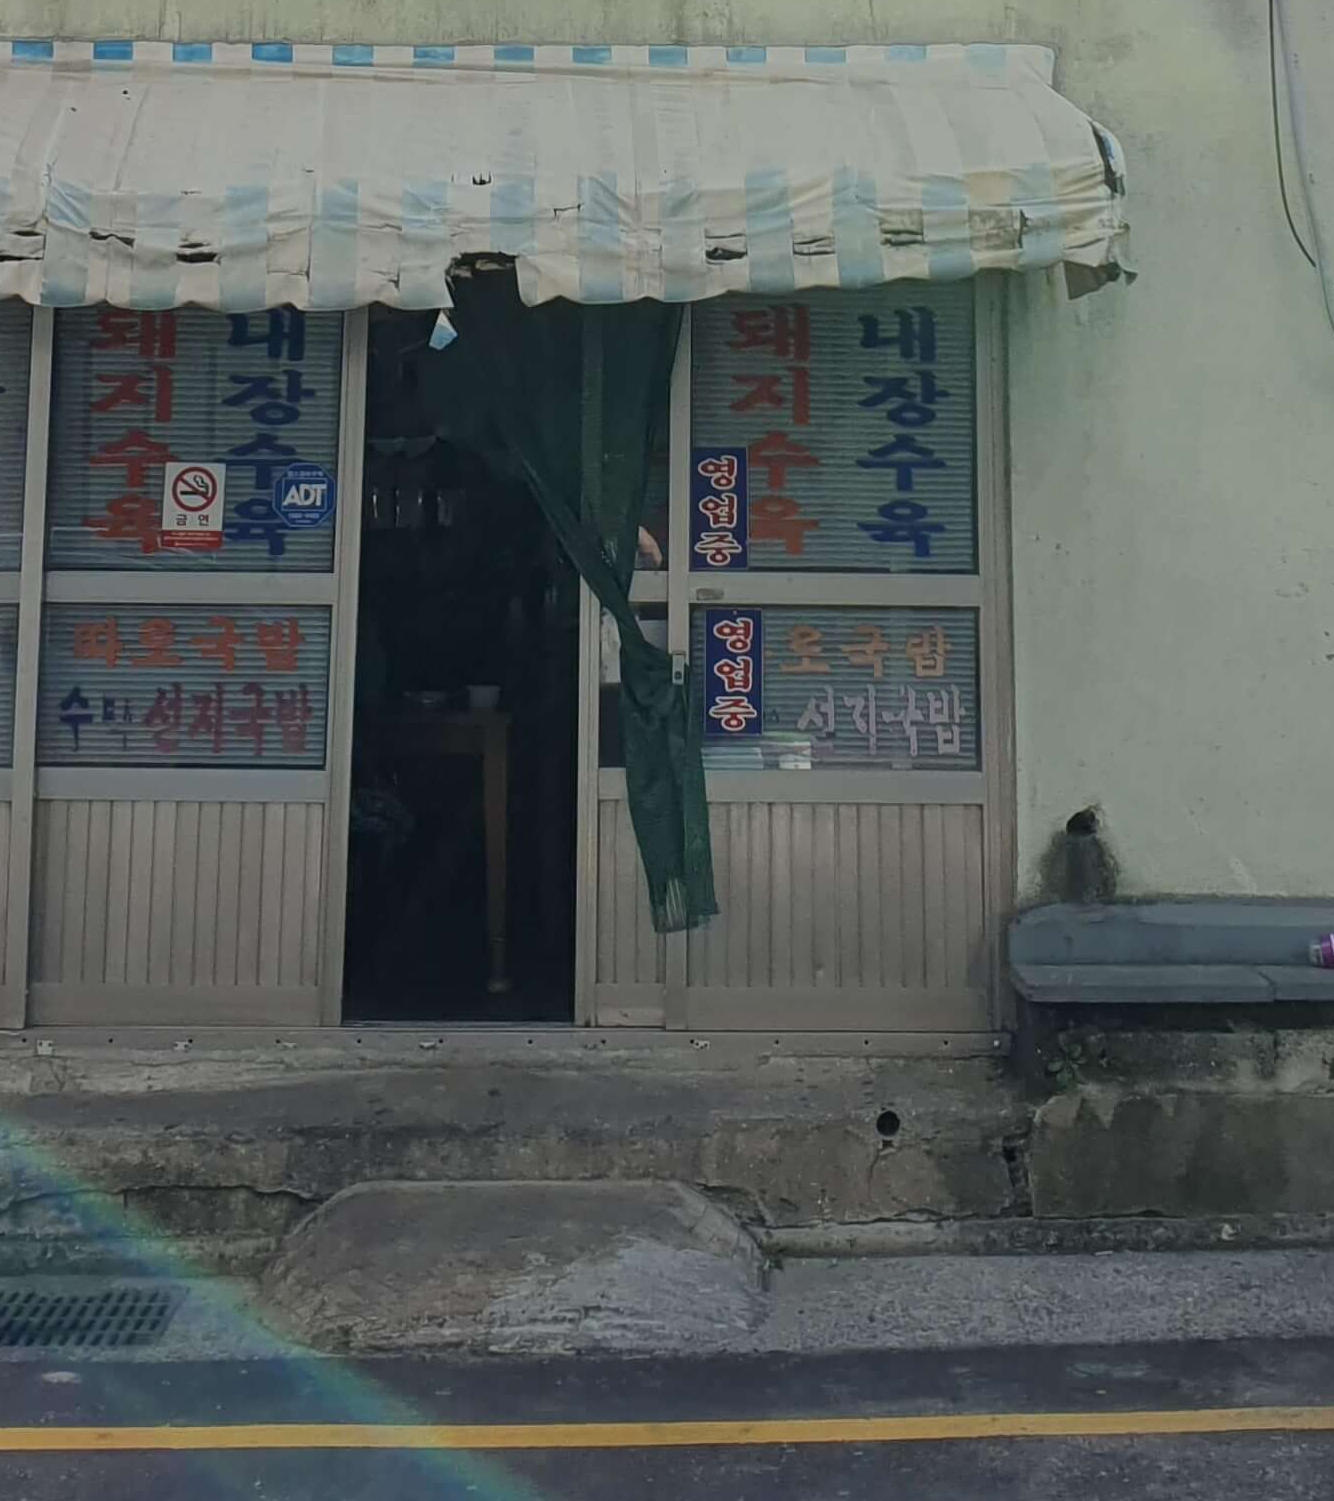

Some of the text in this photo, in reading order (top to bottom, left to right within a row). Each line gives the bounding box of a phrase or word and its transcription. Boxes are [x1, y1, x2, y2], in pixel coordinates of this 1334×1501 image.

[80, 309, 178, 556] 돼지수육
[212, 307, 317, 557] 내장수육
[282, 483, 328, 507] ADT
[694, 455, 743, 567] 영업중
[856, 306, 951, 558] 내장수육
[708, 617, 758, 732] 영업중
